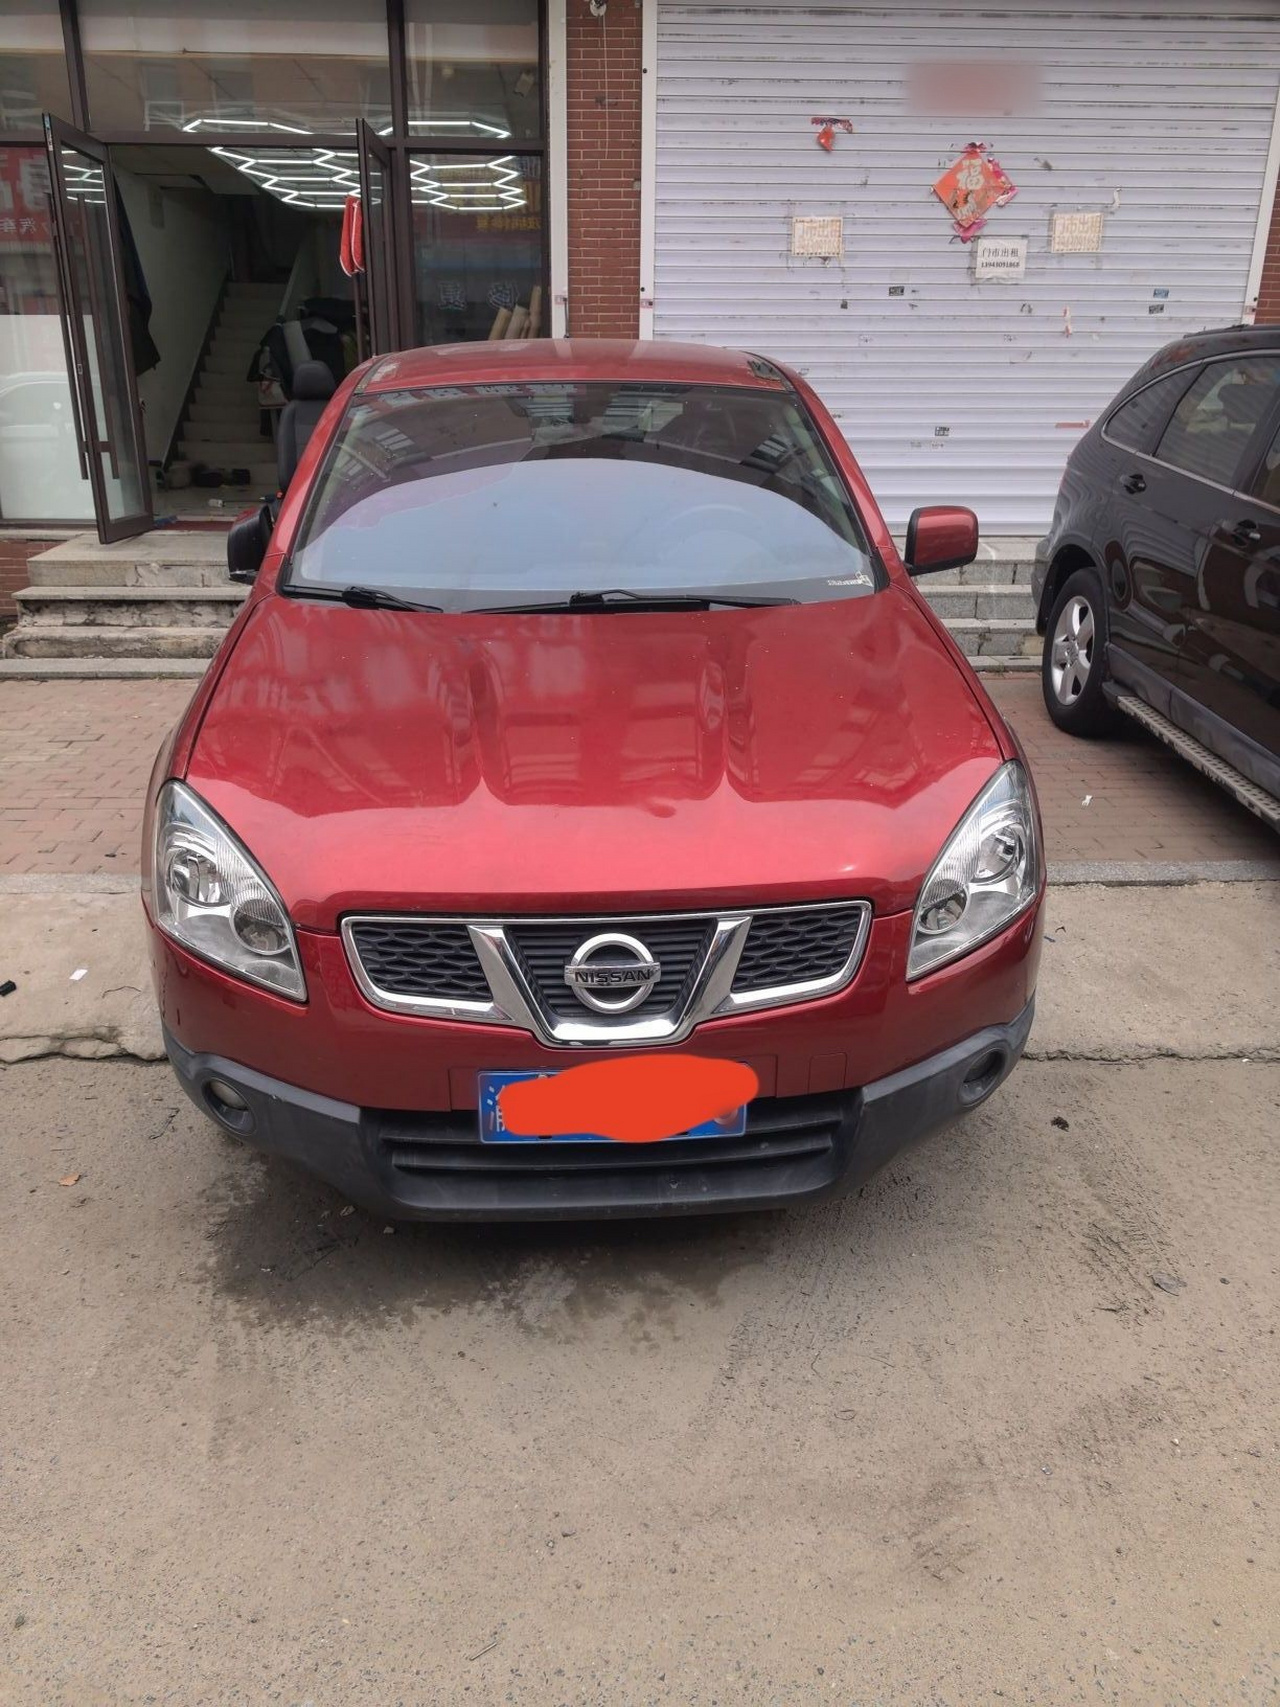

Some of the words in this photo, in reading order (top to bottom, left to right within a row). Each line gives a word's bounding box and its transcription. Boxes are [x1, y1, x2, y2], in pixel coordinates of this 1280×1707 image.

[956, 158, 985, 190] 福
[982, 247, 1019, 257] 门市出租
[575, 969, 651, 983] NISSAN
